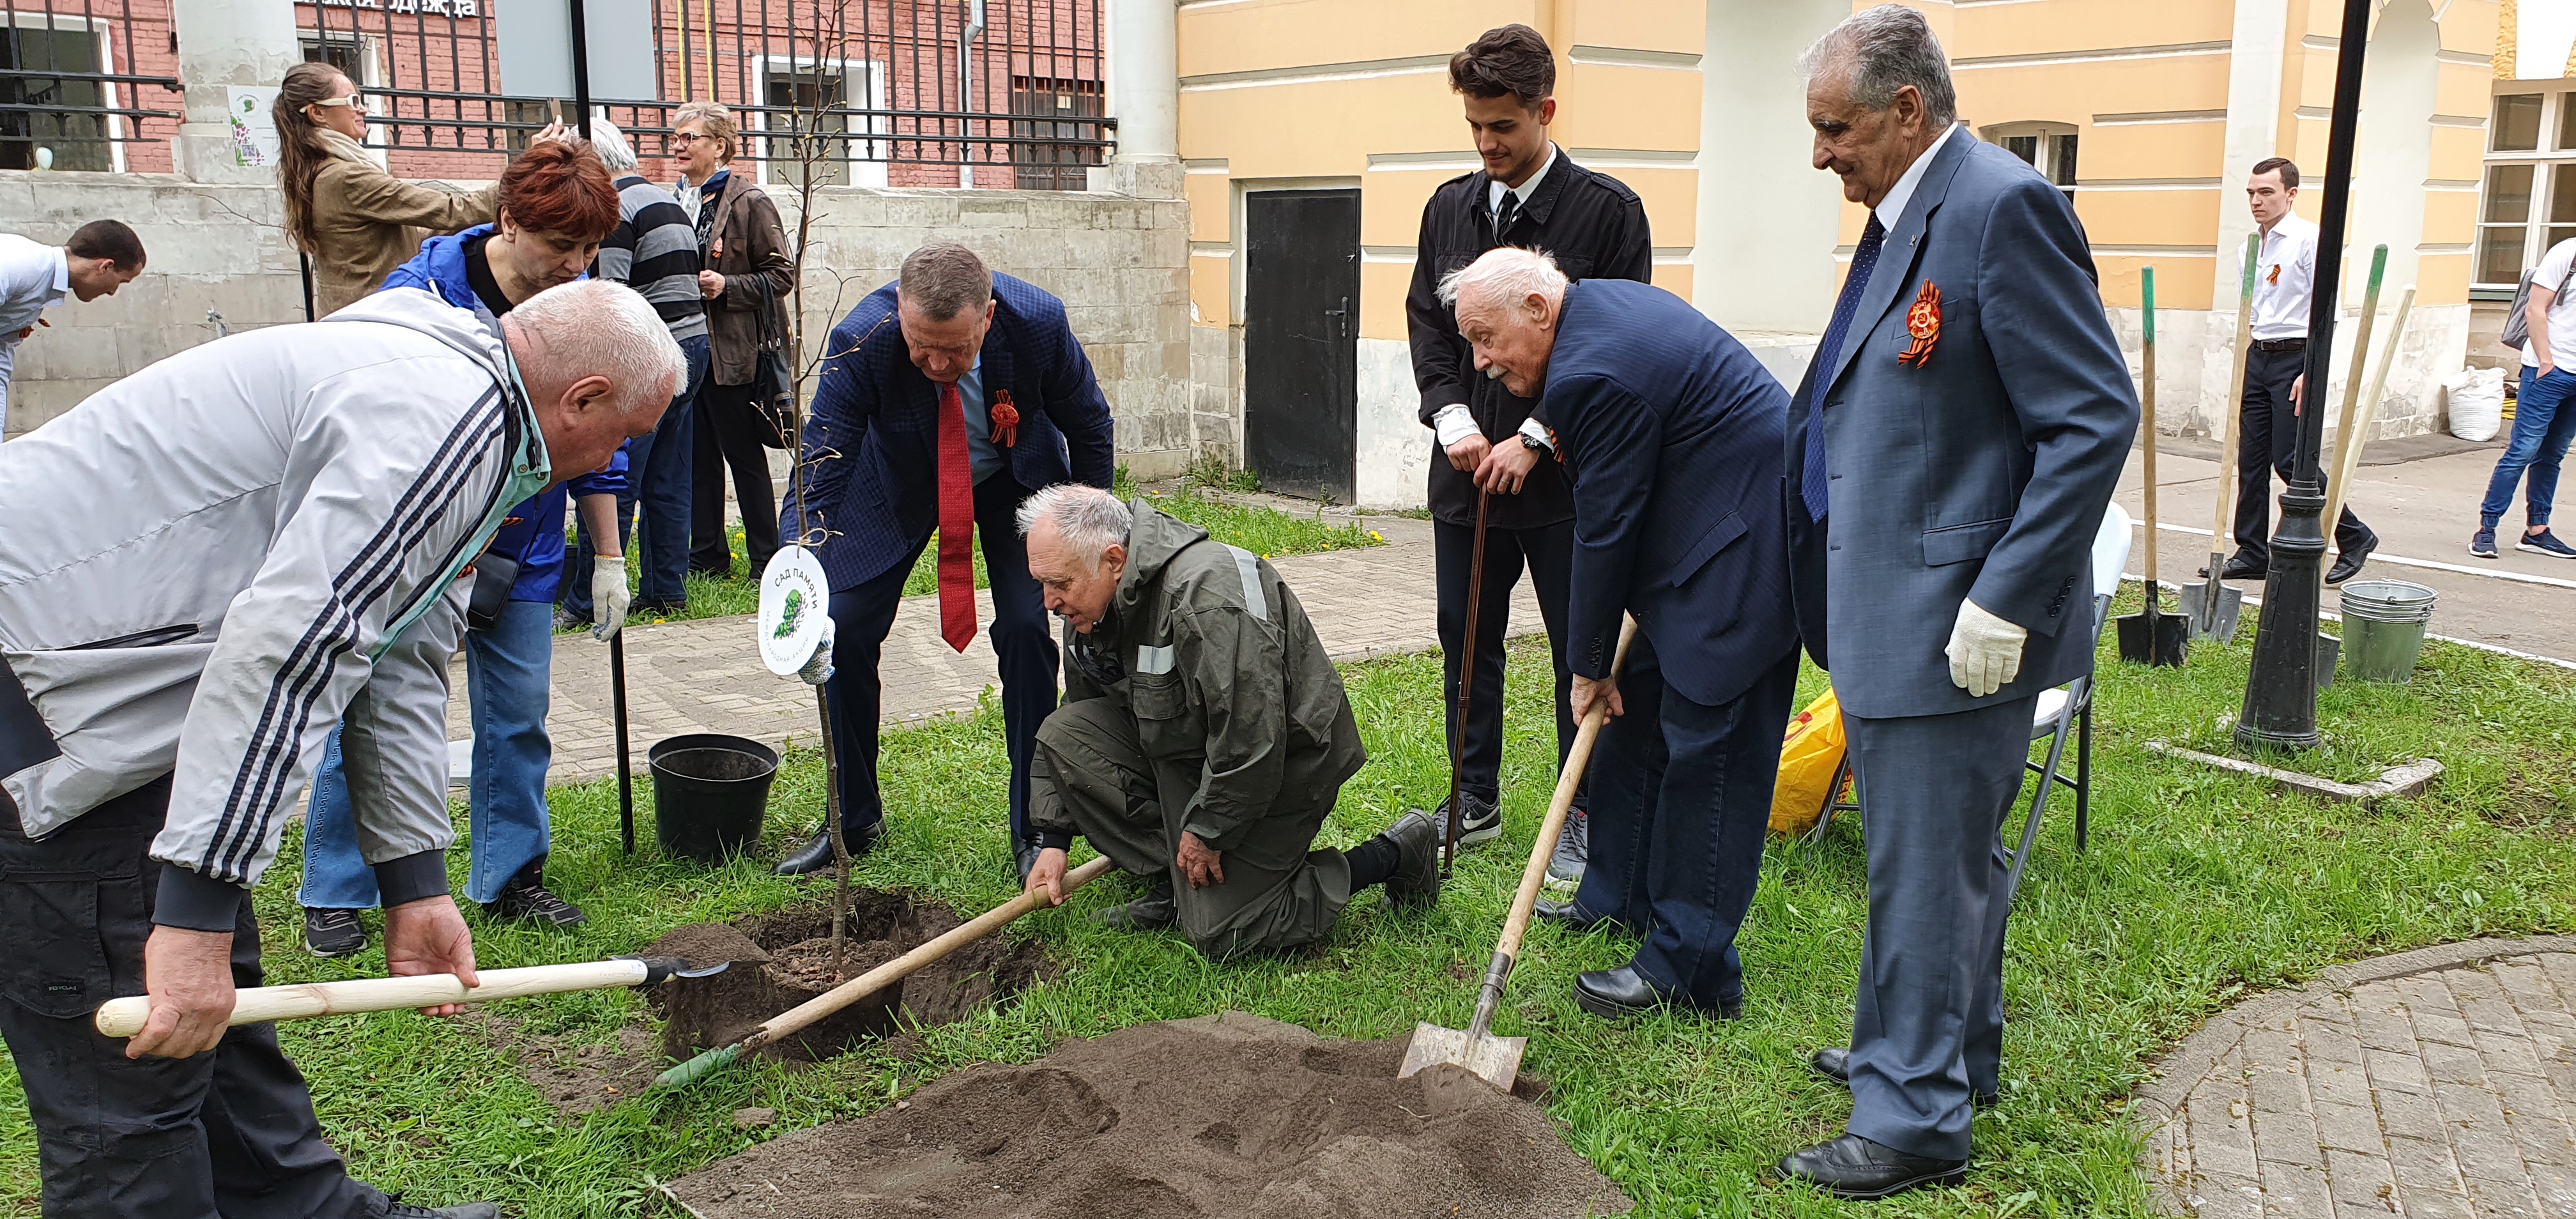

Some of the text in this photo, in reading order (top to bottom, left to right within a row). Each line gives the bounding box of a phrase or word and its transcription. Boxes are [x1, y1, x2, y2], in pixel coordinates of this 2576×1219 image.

[774, 567, 818, 610] САД ПАМЯТИ
[792, 636, 809, 659] АКЦИЯ
